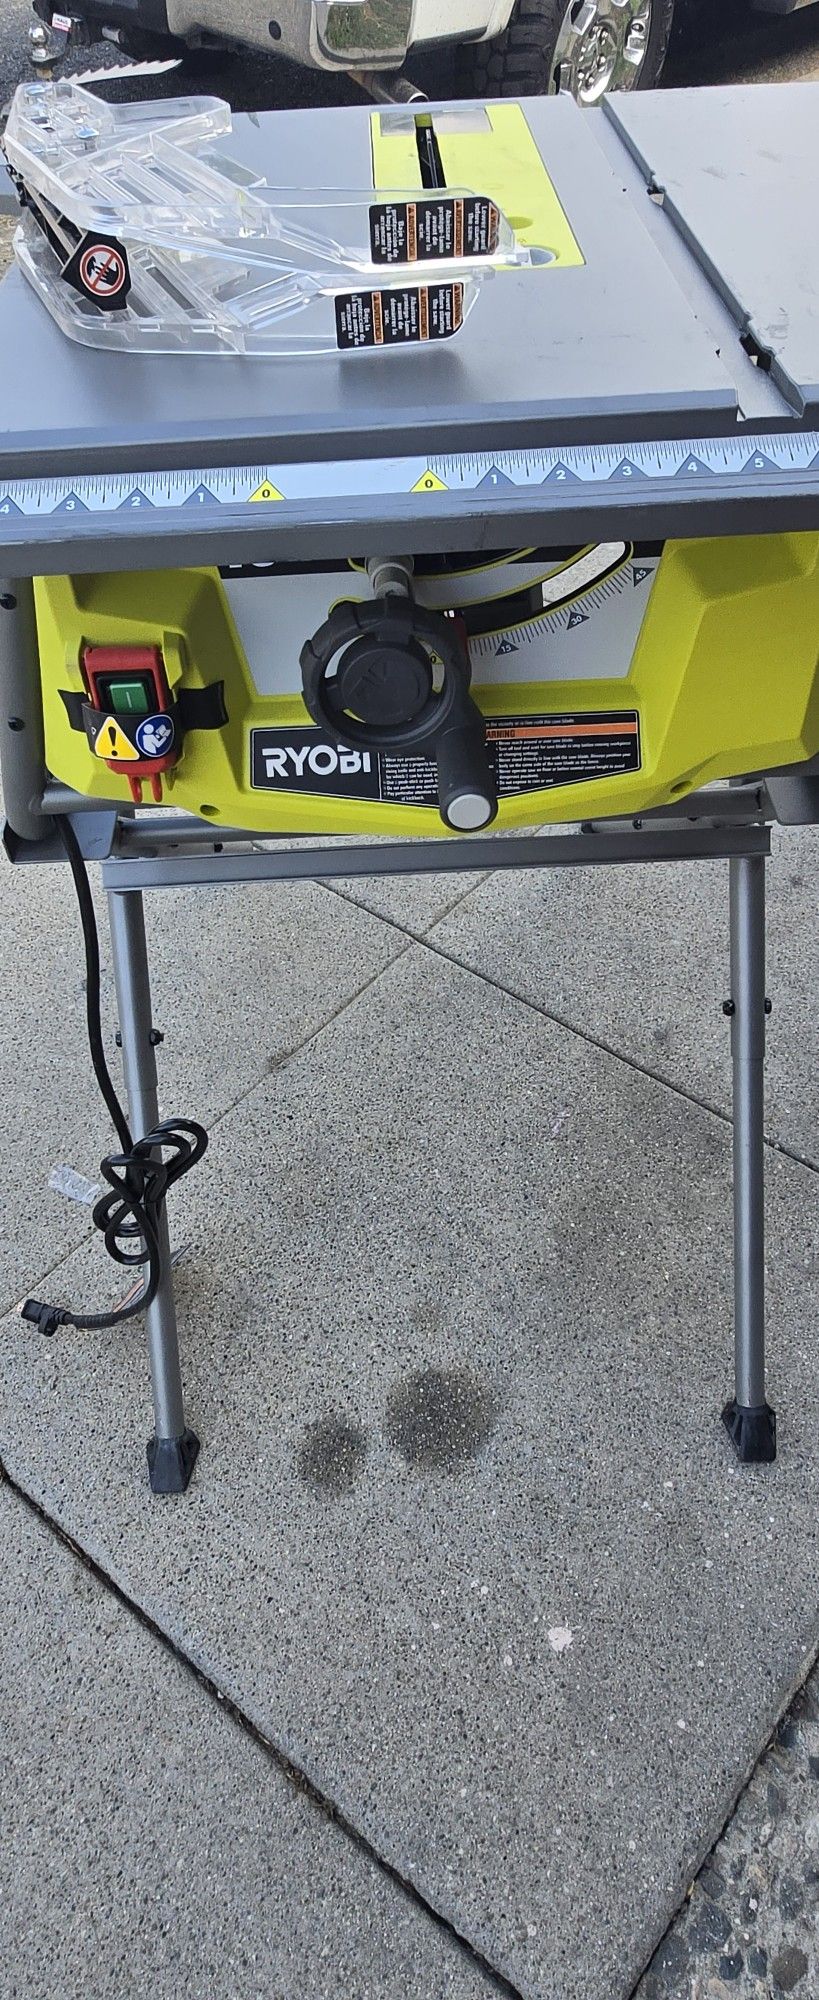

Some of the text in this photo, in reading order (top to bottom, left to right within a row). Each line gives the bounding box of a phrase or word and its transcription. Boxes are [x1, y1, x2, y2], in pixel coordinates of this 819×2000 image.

[66, 501, 75, 510] 3
[131, 497, 140, 506] 2
[198, 493, 203, 502] 1
[262, 489, 270, 498] 0
[491, 475, 498, 484] 1
[556, 471, 566, 479] 2
[623, 466, 632, 475] 3
[688, 462, 698, 471] 4
[755, 459, 764, 468] 5
[635, 569, 646, 580] 45
[572, 615, 582, 624] 30
[262, 744, 371, 778] RYOBI
